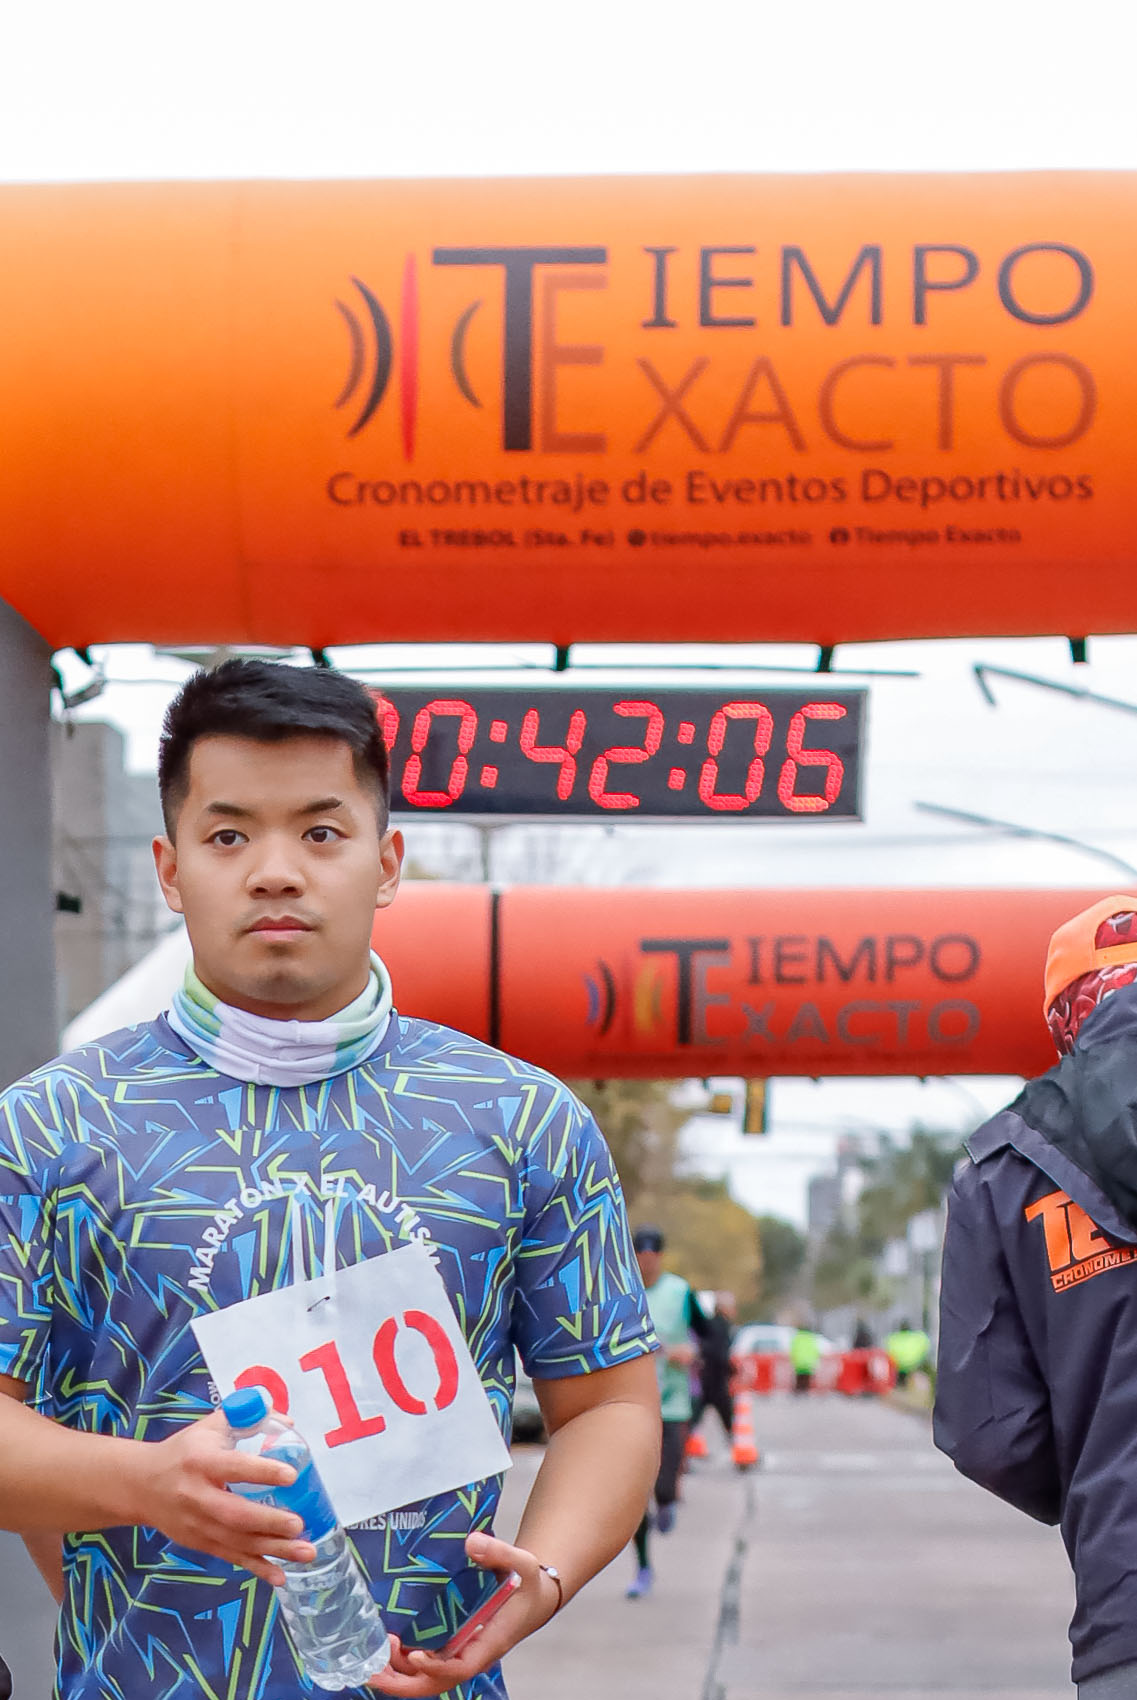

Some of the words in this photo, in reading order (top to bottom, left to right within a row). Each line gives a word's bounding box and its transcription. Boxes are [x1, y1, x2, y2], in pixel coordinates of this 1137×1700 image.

[327, 471, 610, 511] Cronometraje
[622, 471, 672, 504] de
[686, 470, 848, 503] Eventos
[862, 467, 1094, 510] Deportivos
[321, 1174, 349, 1198] EL
